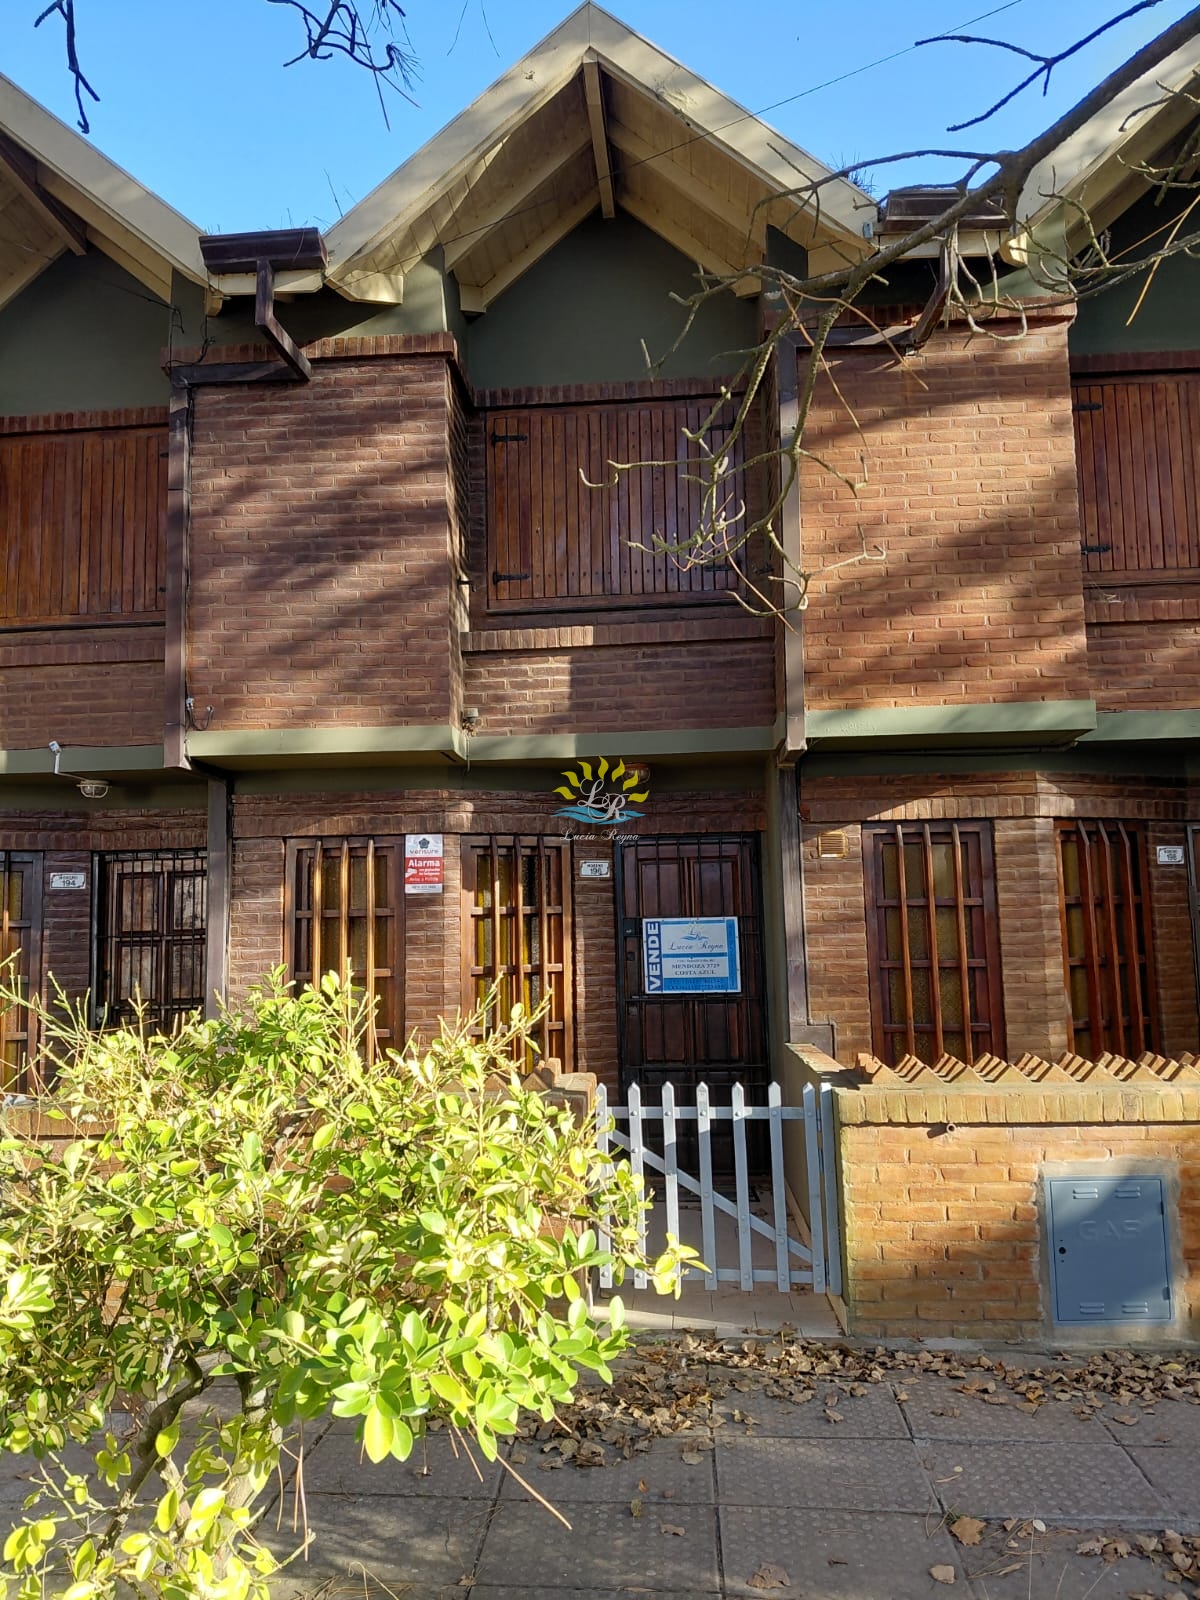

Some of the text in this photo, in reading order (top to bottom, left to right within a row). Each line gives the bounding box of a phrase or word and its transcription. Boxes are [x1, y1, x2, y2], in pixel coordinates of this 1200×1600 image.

[408, 859, 440, 868] Alarma
[62, 879, 76, 887] 194
[647, 922, 662, 991] VENDE
[1079, 1219, 1143, 1241] GAS
